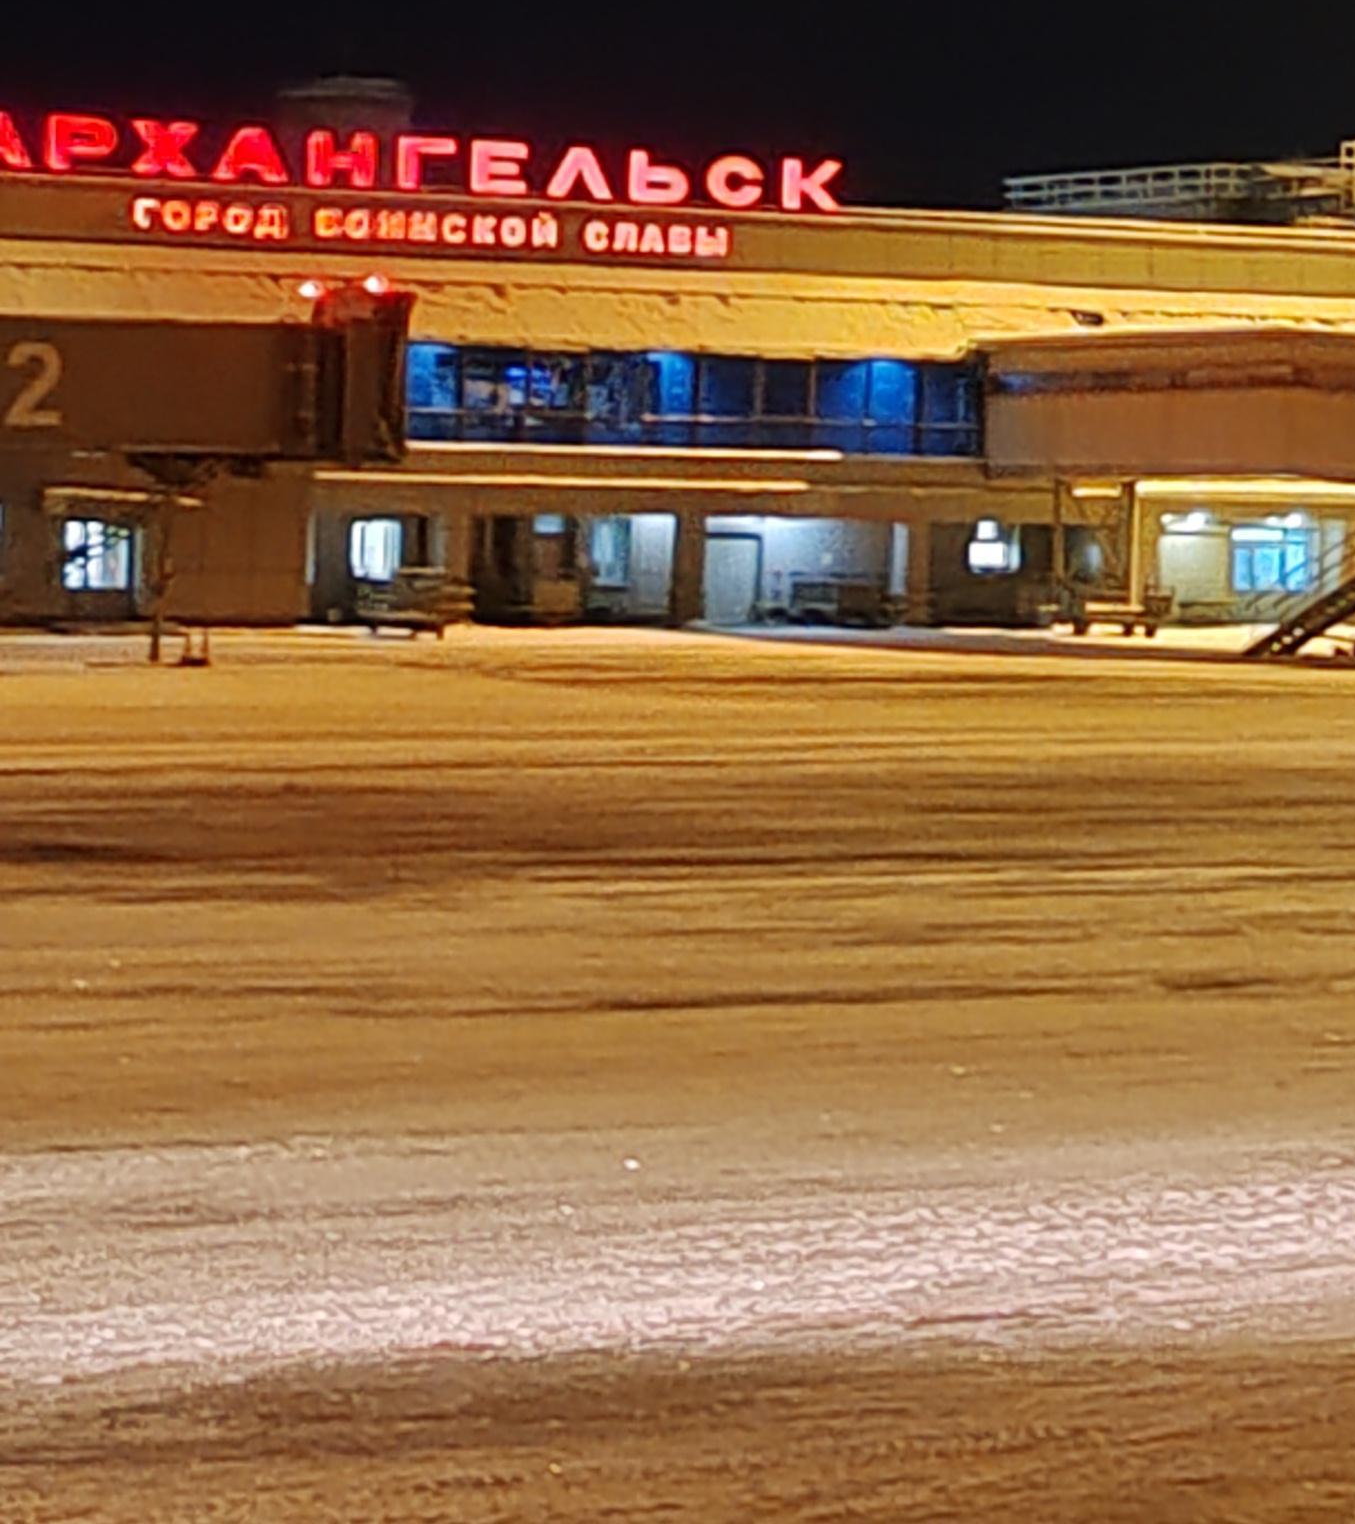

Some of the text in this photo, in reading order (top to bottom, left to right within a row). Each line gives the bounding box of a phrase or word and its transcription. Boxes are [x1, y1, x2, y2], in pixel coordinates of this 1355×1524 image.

[132, 197, 730, 258] ГОРОД ВОИНСКОЙ СЛАВЫ
[5, 341, 62, 427] 2
